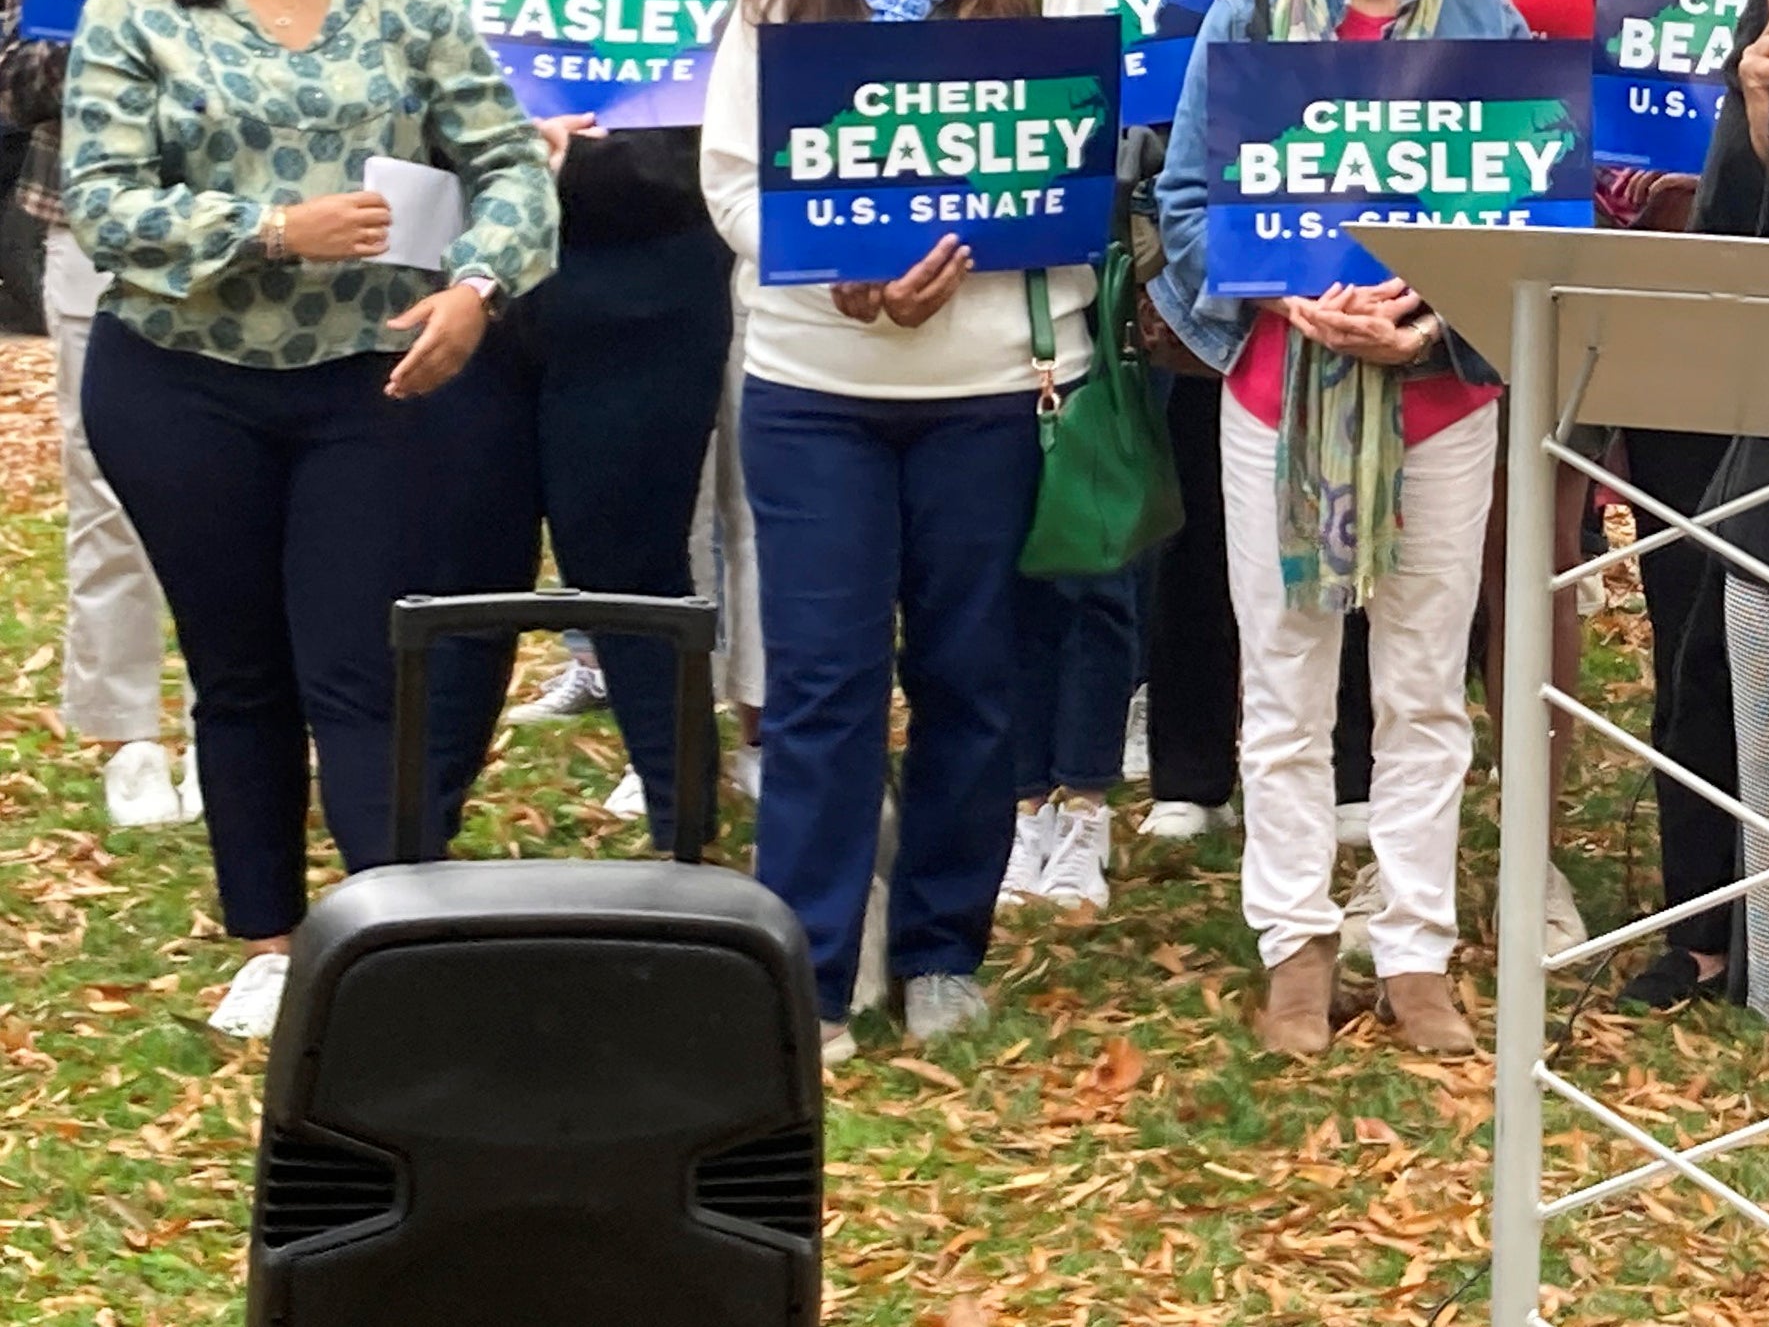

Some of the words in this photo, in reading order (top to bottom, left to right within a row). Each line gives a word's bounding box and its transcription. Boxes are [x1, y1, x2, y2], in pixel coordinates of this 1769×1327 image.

[533, 53, 695, 82] SENATE
[853, 79, 1027, 116] CHERI
[1629, 87, 1698, 119] U.S.
[1302, 100, 1483, 133] CHERI
[790, 117, 1096, 181] BEASLEY
[1240, 140, 1563, 195] BEASLEY
[807, 197, 890, 226] U.S.
[909, 187, 1066, 222] SENATE
[1255, 212, 1337, 239] U.S.
